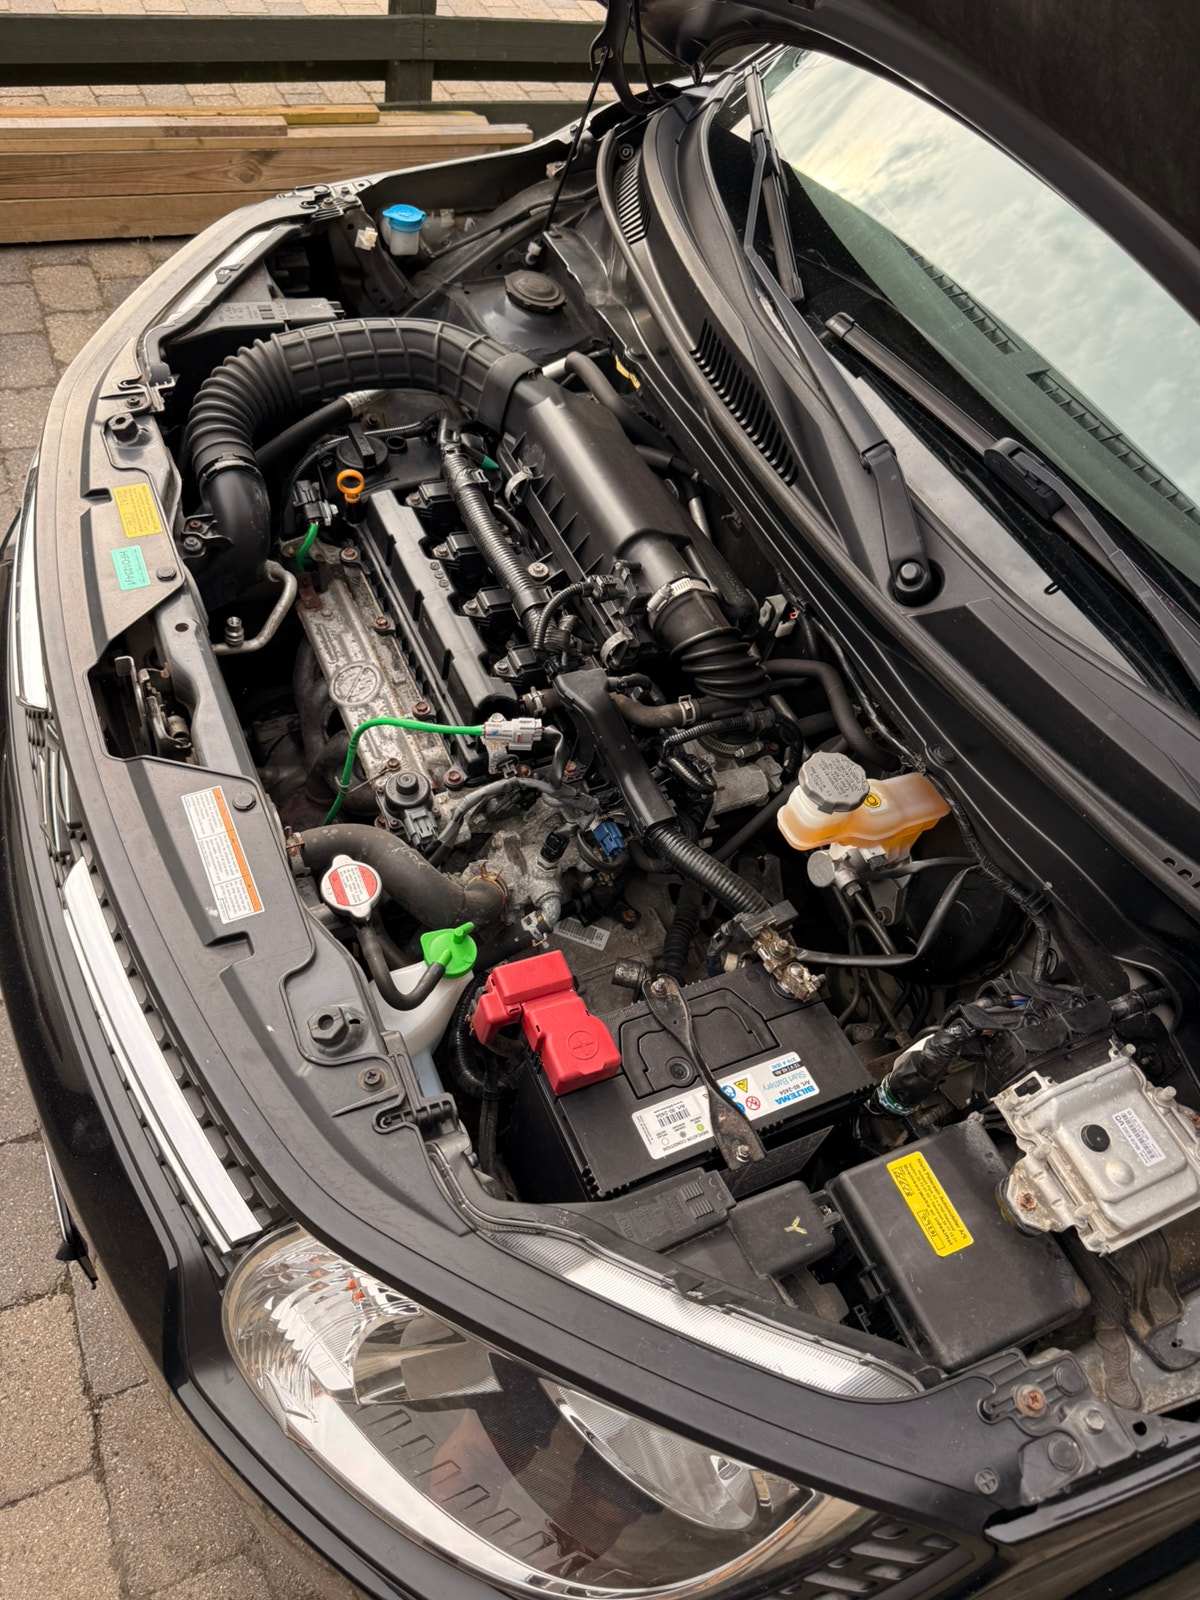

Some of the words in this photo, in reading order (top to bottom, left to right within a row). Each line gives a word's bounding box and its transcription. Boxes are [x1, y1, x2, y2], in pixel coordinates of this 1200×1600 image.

[761, 1076, 788, 1092] Battery
[787, 1070, 806, 1083] Start
[774, 1084, 815, 1105] BILTEMA
